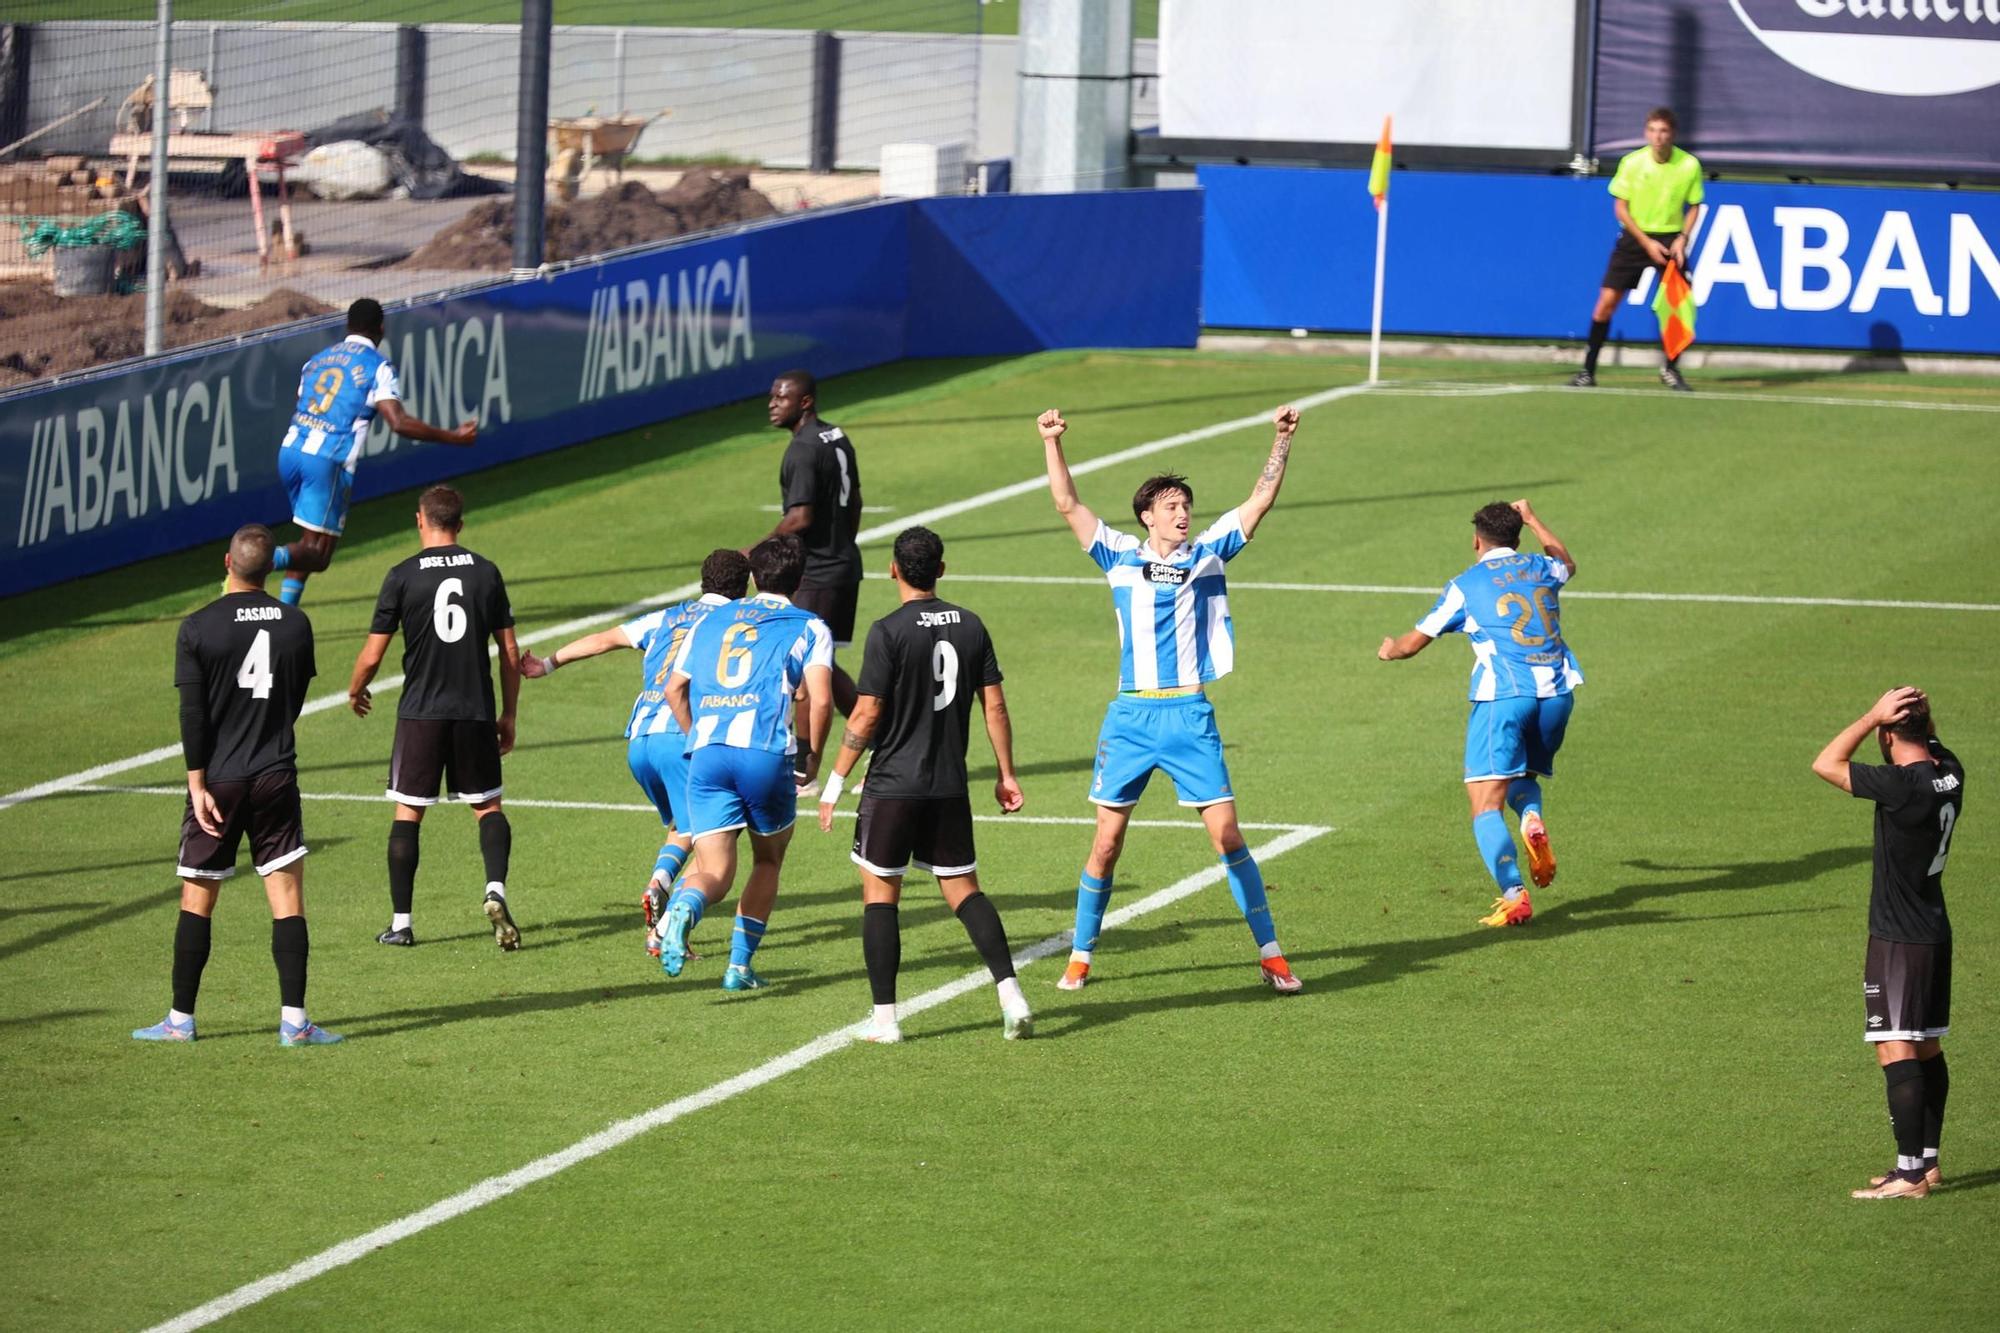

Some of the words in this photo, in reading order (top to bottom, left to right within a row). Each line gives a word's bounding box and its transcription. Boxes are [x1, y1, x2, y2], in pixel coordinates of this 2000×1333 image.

[307, 368, 344, 415] 9
[419, 556, 445, 569] JOSE
[445, 554, 474, 566] LARA
[433, 577, 467, 643] 6
[237, 628, 273, 699] 4
[716, 622, 758, 689] 6
[932, 640, 959, 711] 9
[1927, 802, 1956, 876] 2
